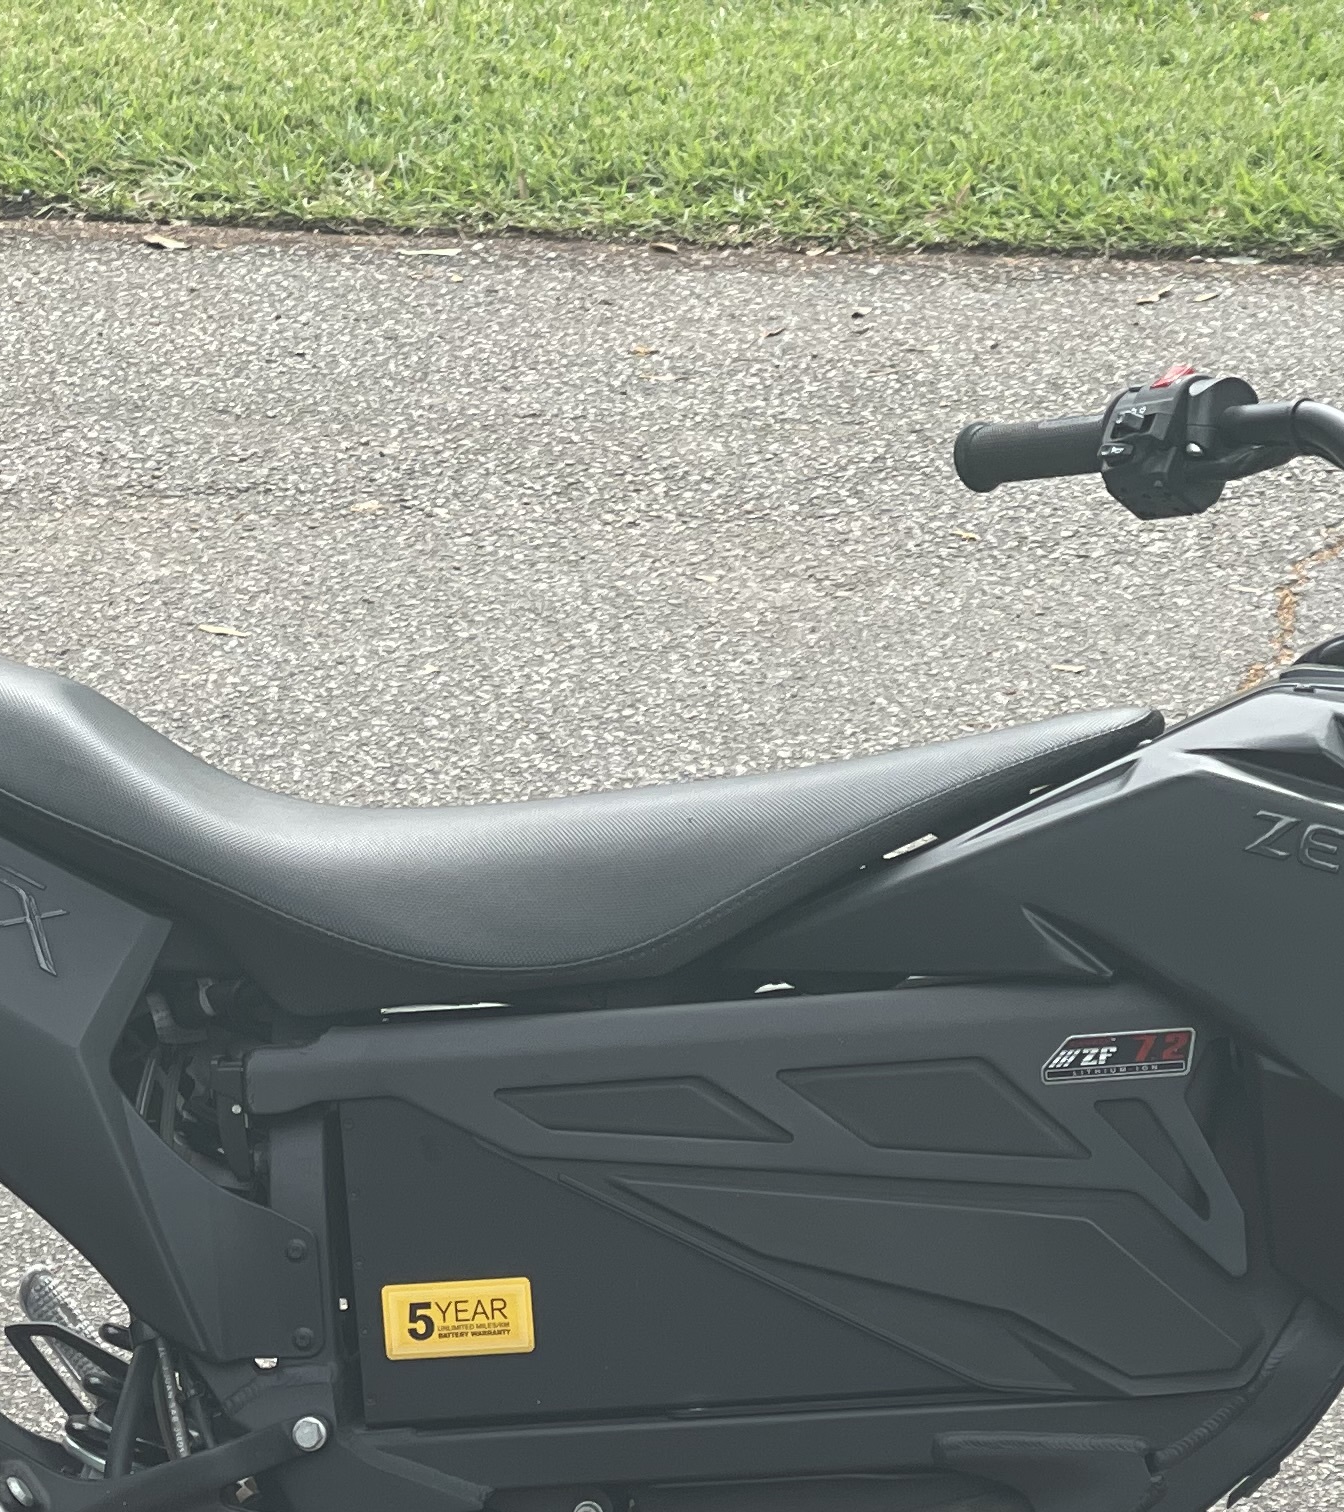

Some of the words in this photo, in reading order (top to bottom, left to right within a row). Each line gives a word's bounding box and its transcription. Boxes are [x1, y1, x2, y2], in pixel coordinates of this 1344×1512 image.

[407, 1302, 435, 1341] 5
[434, 1298, 508, 1323] YEAR
[438, 1331, 469, 1340] BATTERY
